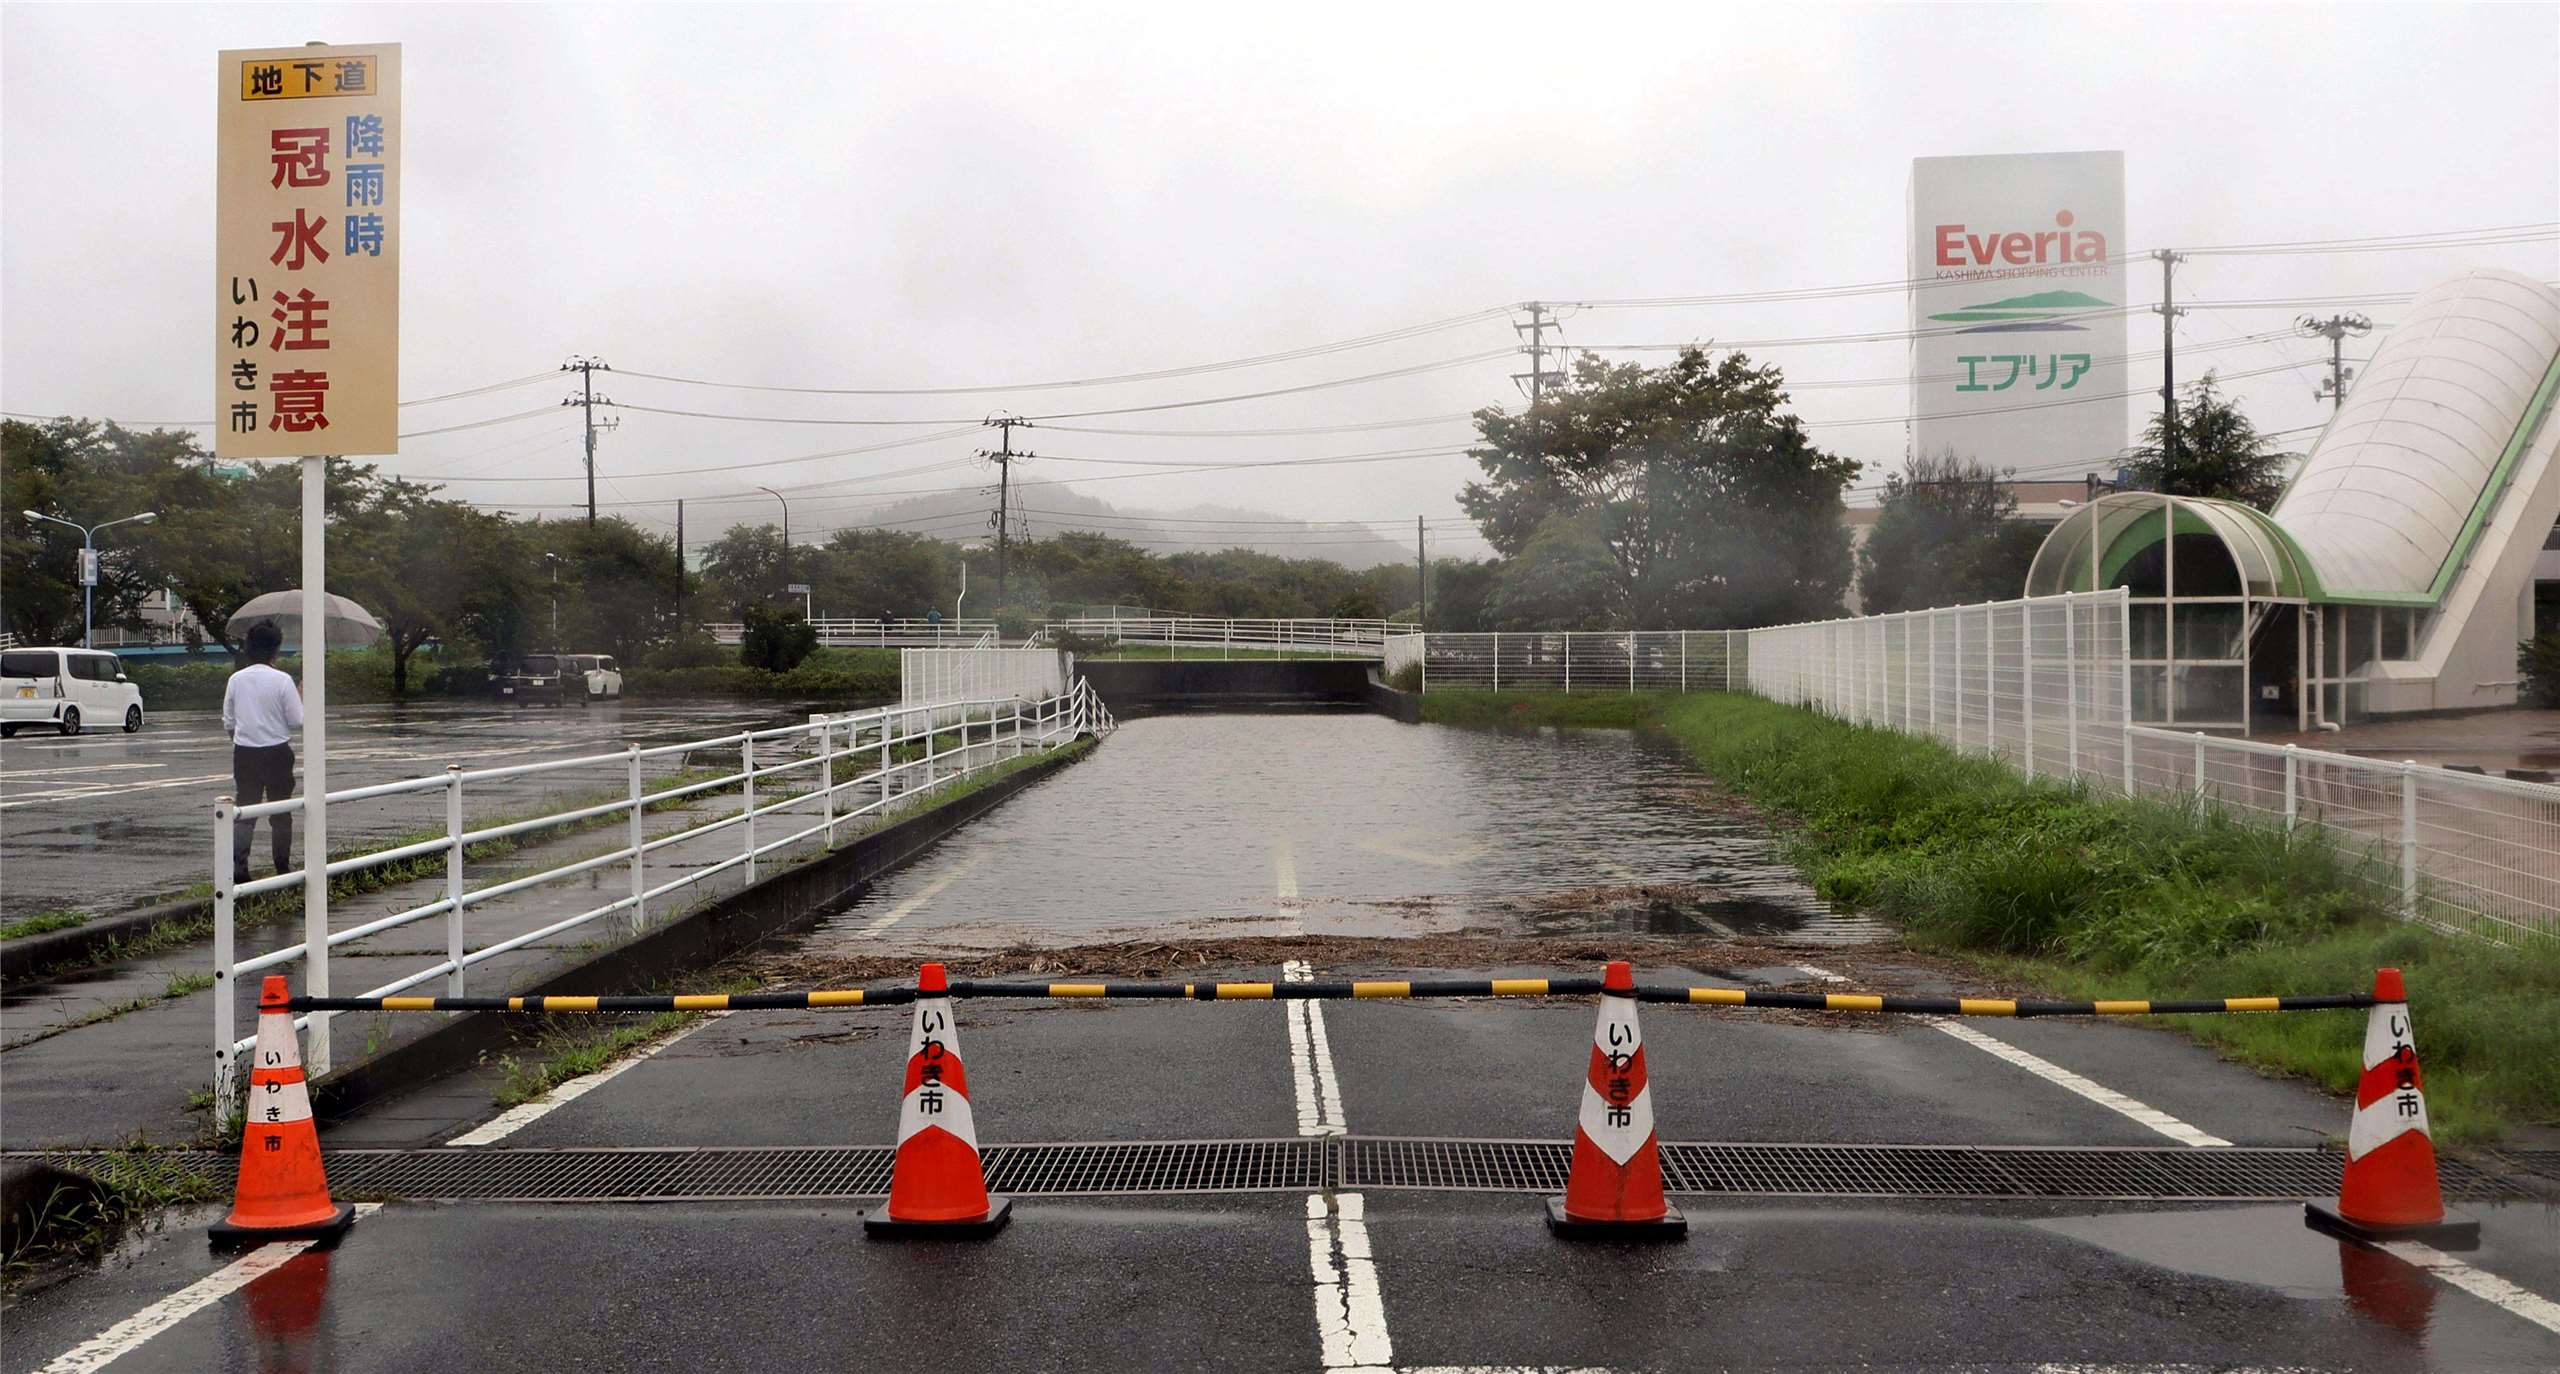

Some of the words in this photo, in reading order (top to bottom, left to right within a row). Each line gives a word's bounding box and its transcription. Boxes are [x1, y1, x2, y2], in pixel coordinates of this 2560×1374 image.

[251, 61, 367, 96] 地下道
[344, 113, 386, 258] 降雨時
[1935, 209, 2107, 267] Everia
[267, 126, 332, 433] 冠水注意
[230, 275, 260, 434] いわき市
[1955, 353, 2092, 392] エブリア
[264, 1051, 283, 1153] いわき市
[919, 1009, 945, 1115] いわき市
[1607, 1022, 1633, 1129] いわき市
[2390, 1014, 2419, 1119] いわき市
